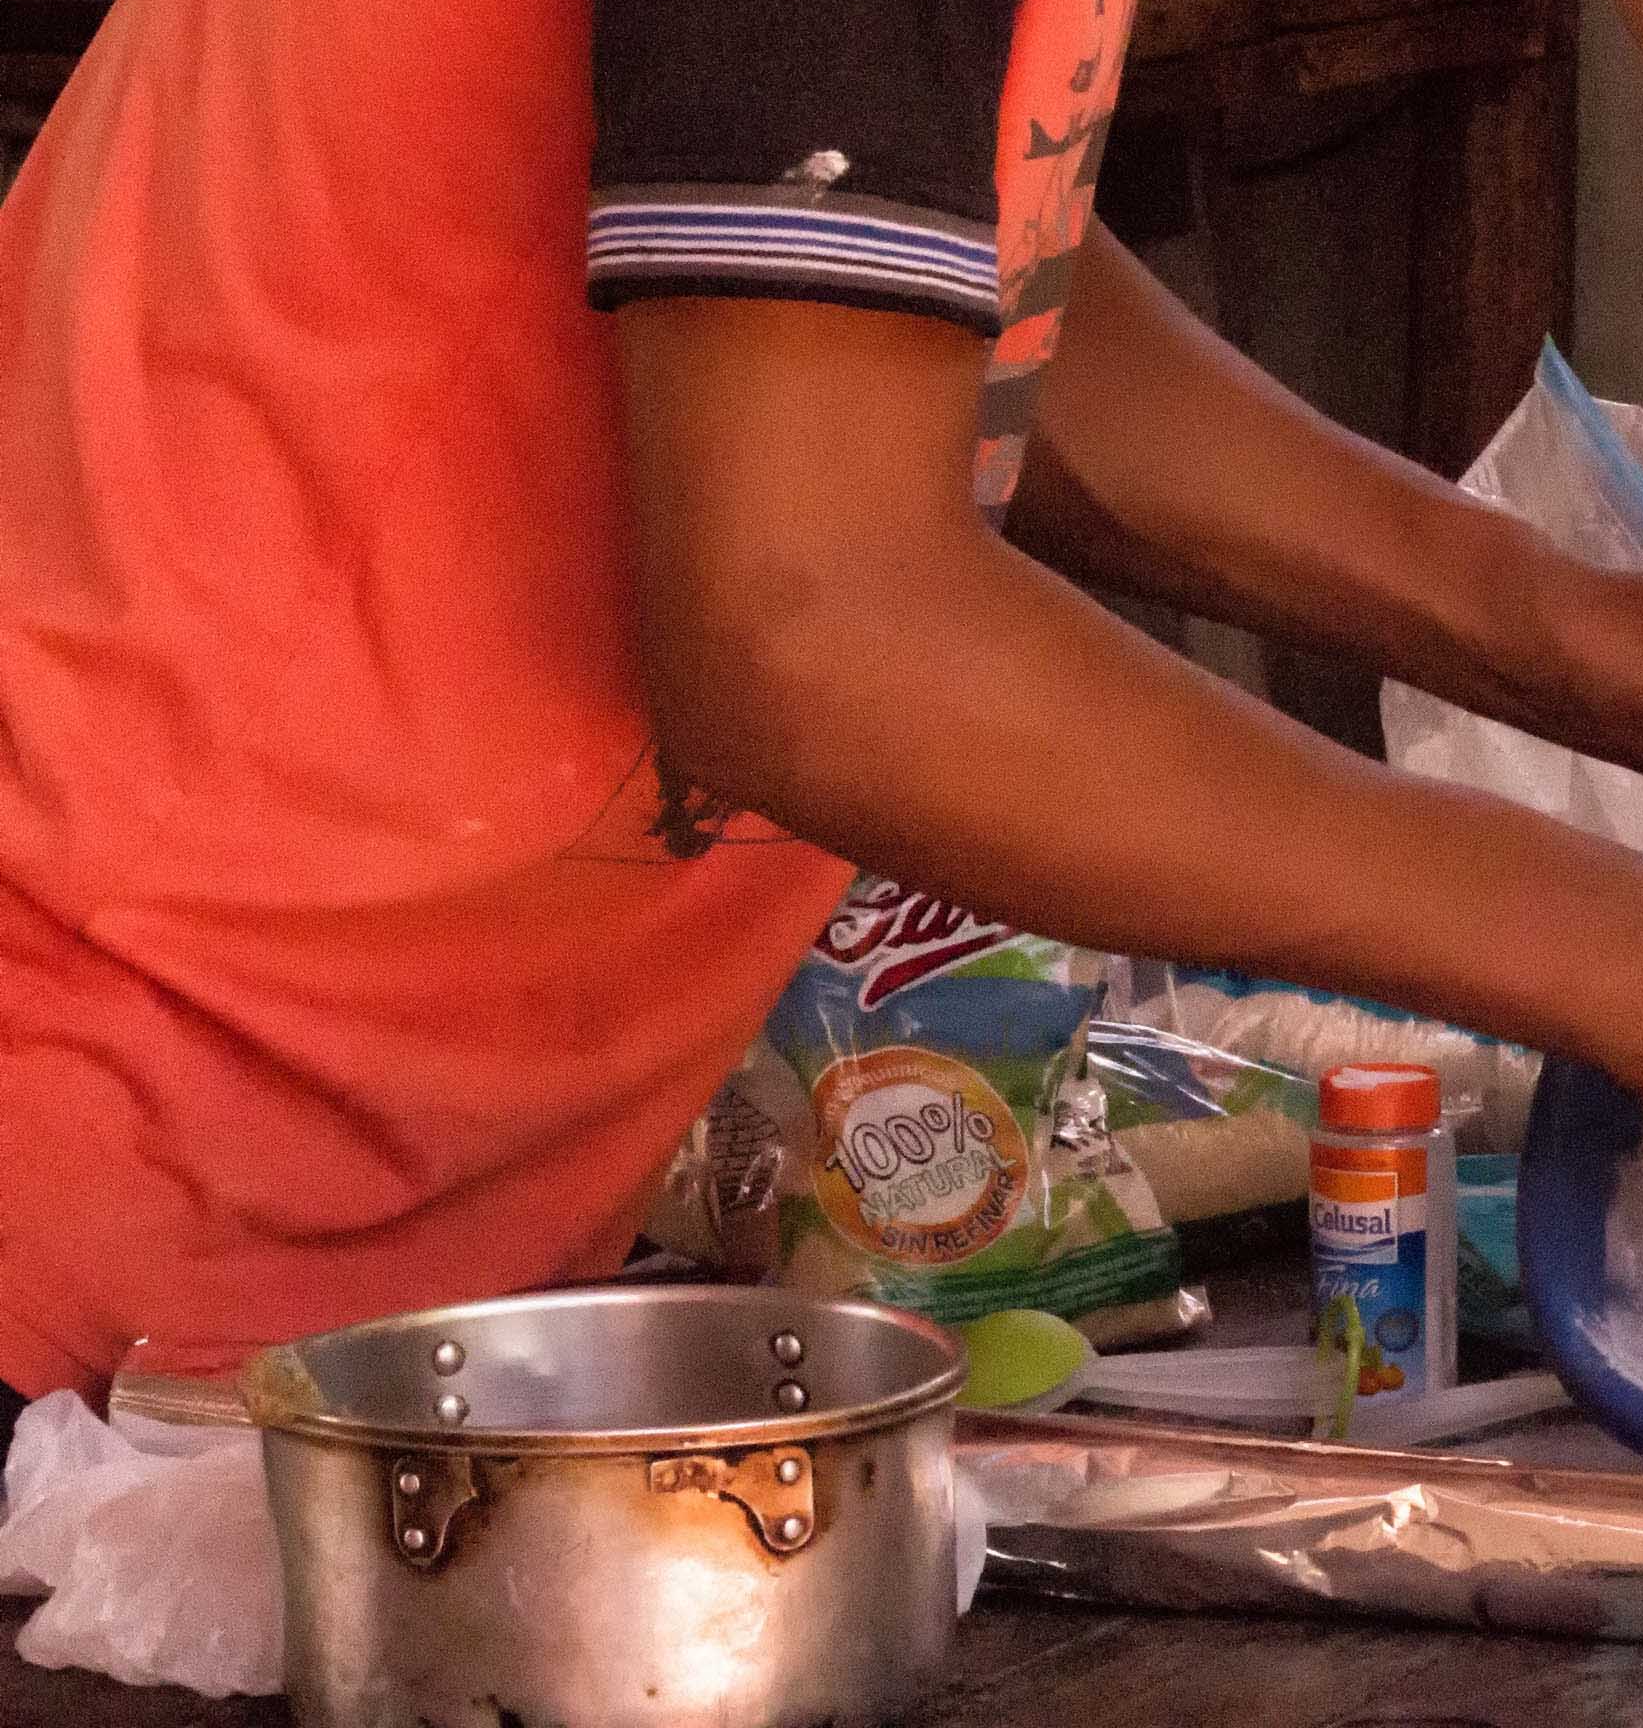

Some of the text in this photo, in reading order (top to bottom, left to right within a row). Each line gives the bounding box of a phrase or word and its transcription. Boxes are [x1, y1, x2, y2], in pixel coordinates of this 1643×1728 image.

[825, 1090, 997, 1194] 100%
[858, 1145, 1017, 1227] NATURAL
[1314, 1202, 1392, 1235] Celusal
[881, 1225, 927, 1254] SIN
[1316, 1264, 1381, 1300] Fina
